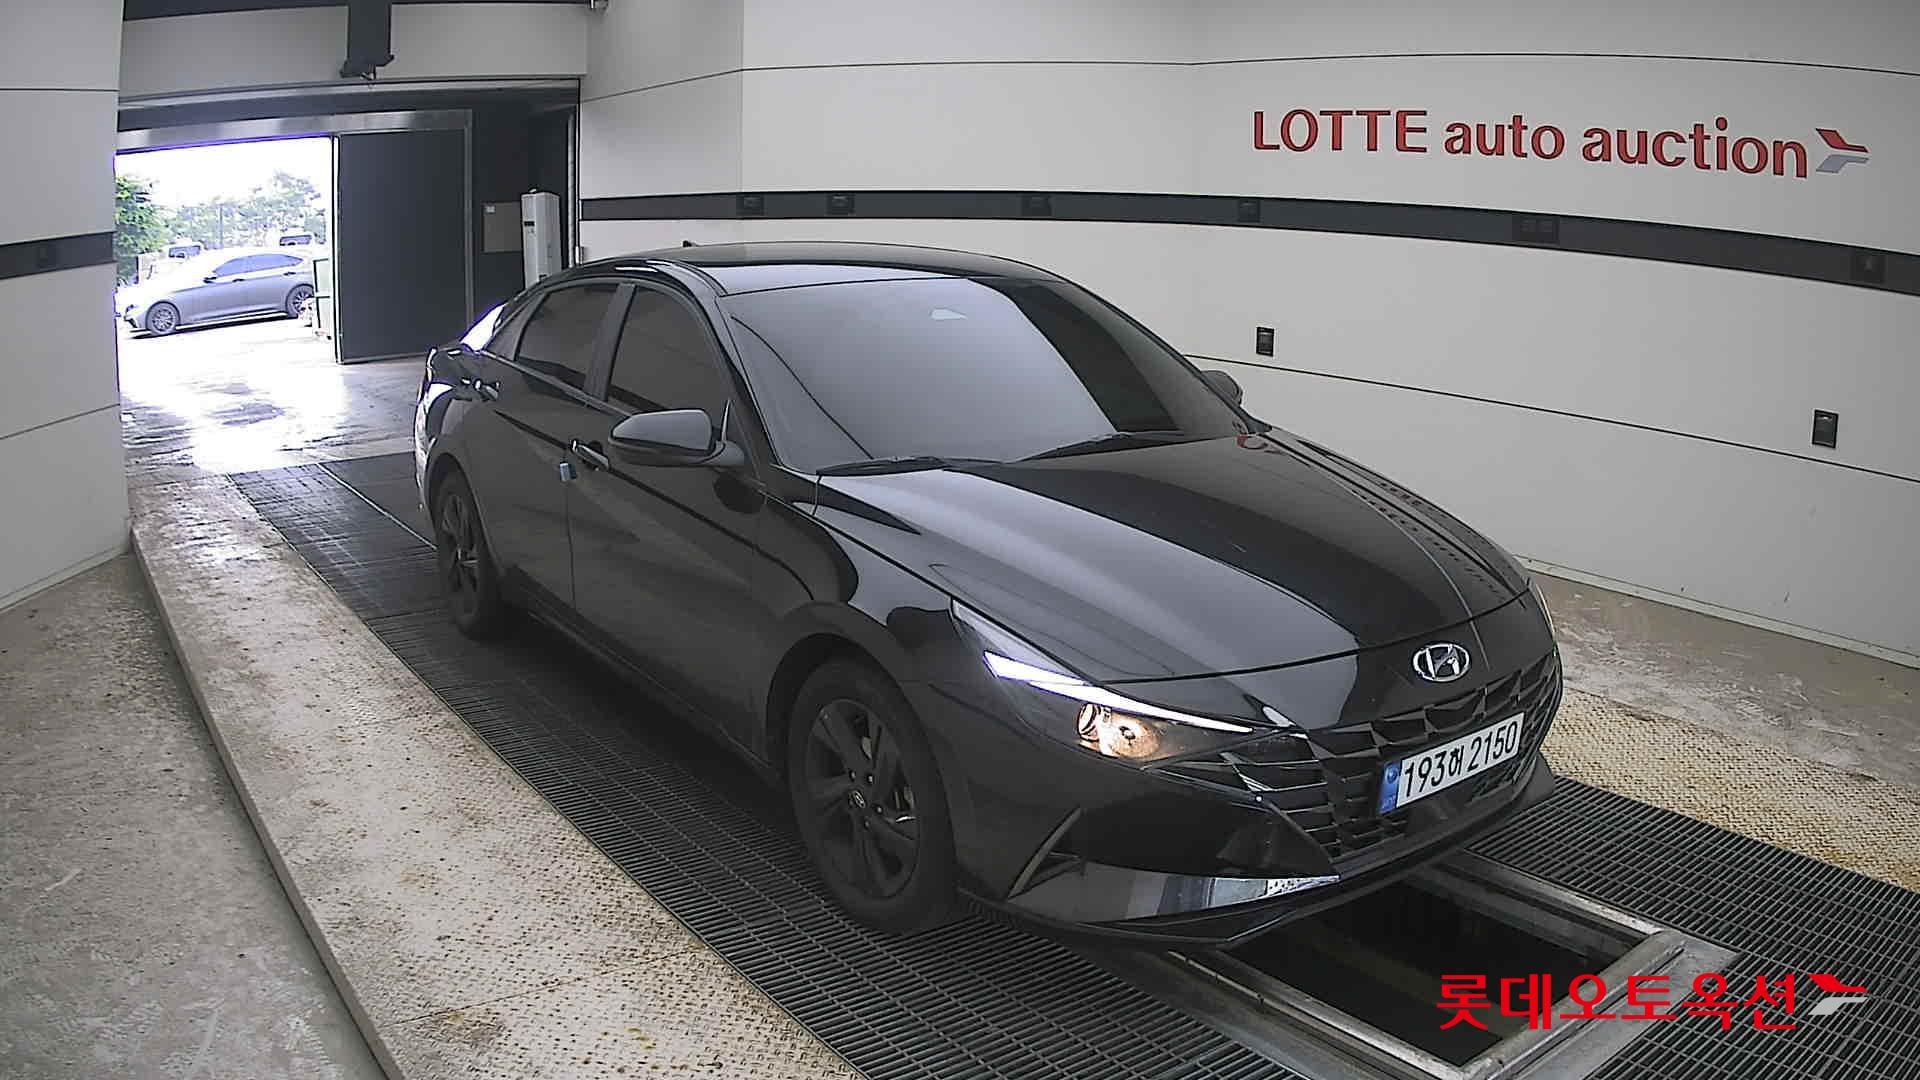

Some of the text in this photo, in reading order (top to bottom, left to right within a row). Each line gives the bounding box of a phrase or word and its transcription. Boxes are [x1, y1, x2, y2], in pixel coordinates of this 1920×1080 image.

[1253, 109, 1808, 179] LOTTE auto auction
[1404, 721, 1518, 798] 193허 2150
